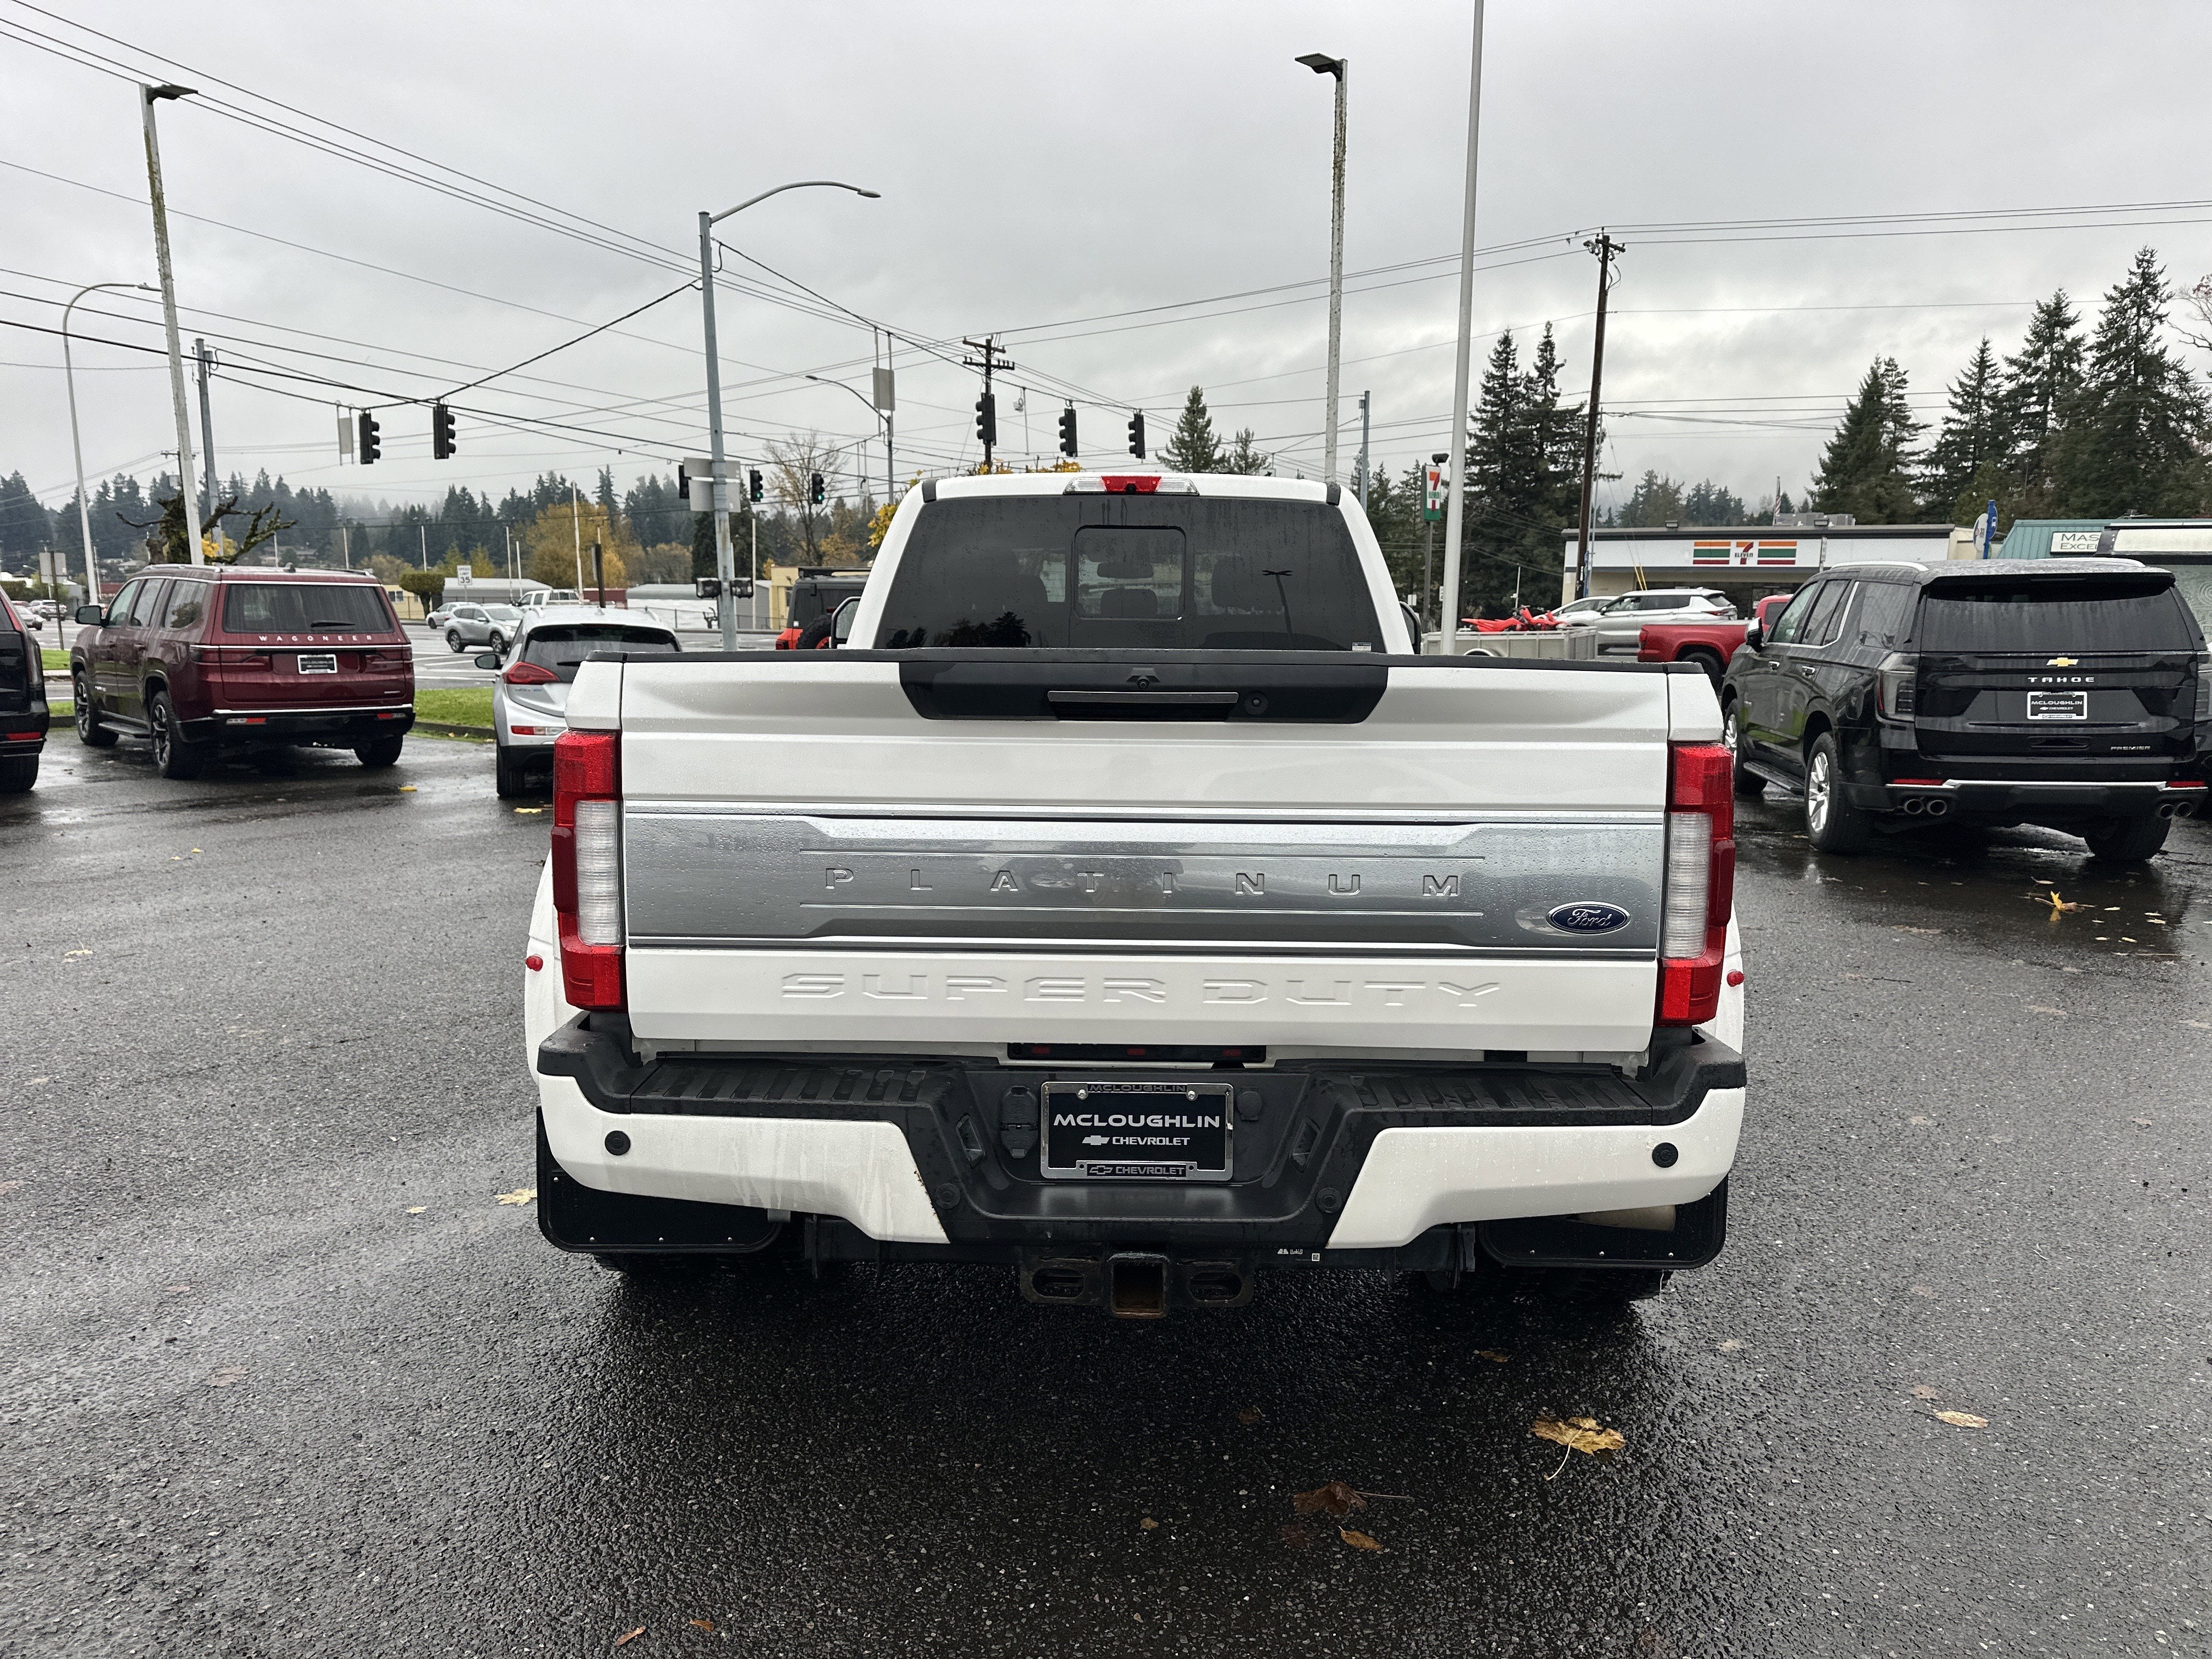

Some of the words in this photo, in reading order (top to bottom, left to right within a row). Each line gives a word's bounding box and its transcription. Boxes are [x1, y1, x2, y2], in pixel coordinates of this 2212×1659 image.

[1736, 541, 1754, 565] 7
[825, 868, 1459, 896] PLATINUM
[1567, 909, 1612, 927] Ford
[782, 973, 1166, 1003] SUPER
[1203, 979, 1500, 1007] DUTY
[1090, 1084, 1187, 1093] MCLOUGHLIN
[1053, 1114, 1220, 1128] MCLOUGHLIN
[1112, 1136, 1190, 1146] CHEVROLET
[1115, 1166, 1185, 1175] CHEVROLET
